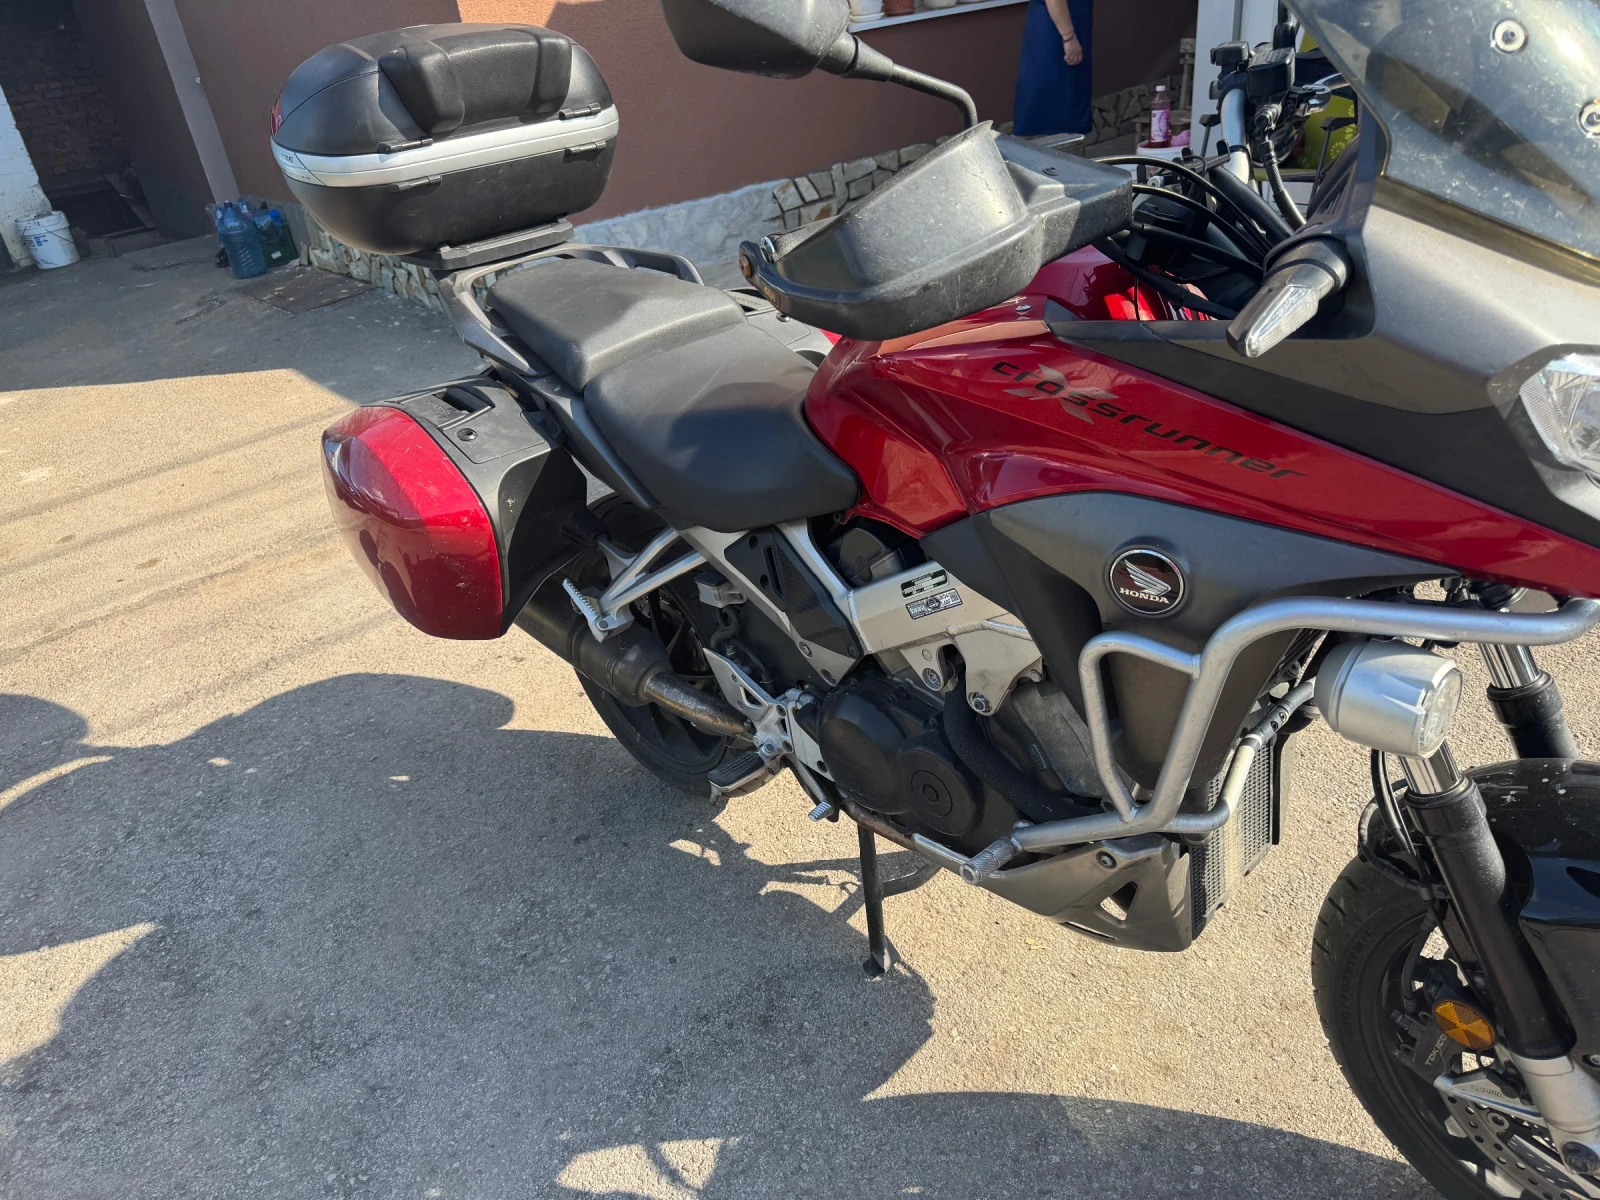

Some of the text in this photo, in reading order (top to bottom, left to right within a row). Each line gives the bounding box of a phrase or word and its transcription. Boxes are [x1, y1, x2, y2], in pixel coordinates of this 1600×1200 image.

[991, 361, 1307, 479] crossrunner
[1119, 586, 1170, 604] HONDA
[1424, 1033, 1448, 1066] TOKICO
